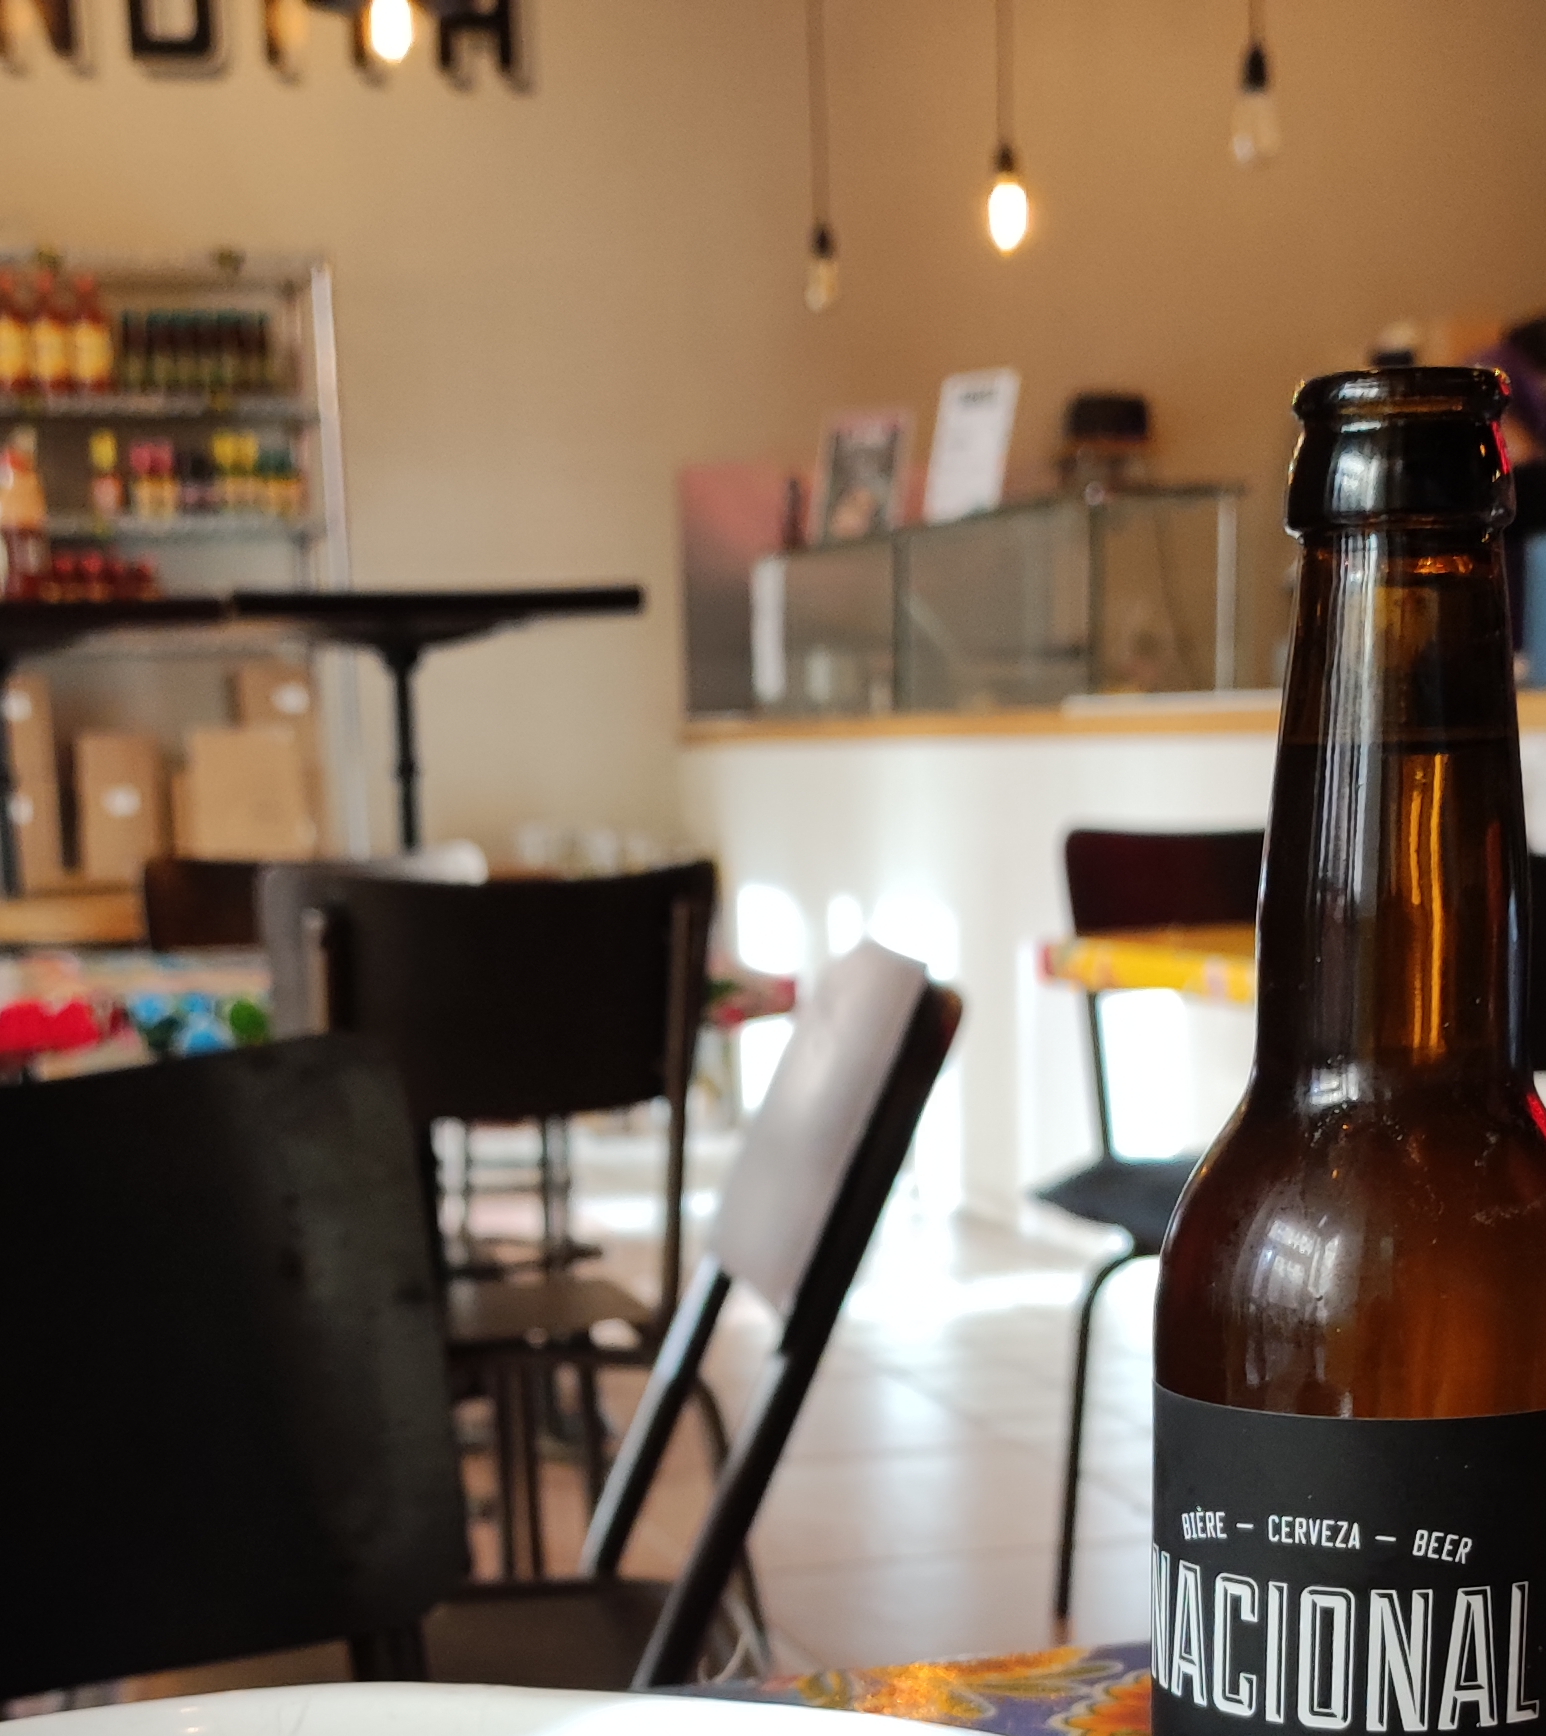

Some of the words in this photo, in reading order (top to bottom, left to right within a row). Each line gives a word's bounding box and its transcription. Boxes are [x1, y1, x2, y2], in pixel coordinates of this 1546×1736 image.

[1181, 1506, 1228, 1541] BIÈRE
[1268, 1514, 1361, 1550] CERVEZA
[1412, 1529, 1473, 1564] BEER
[1151, 1541, 1541, 1733] NACIONAL
